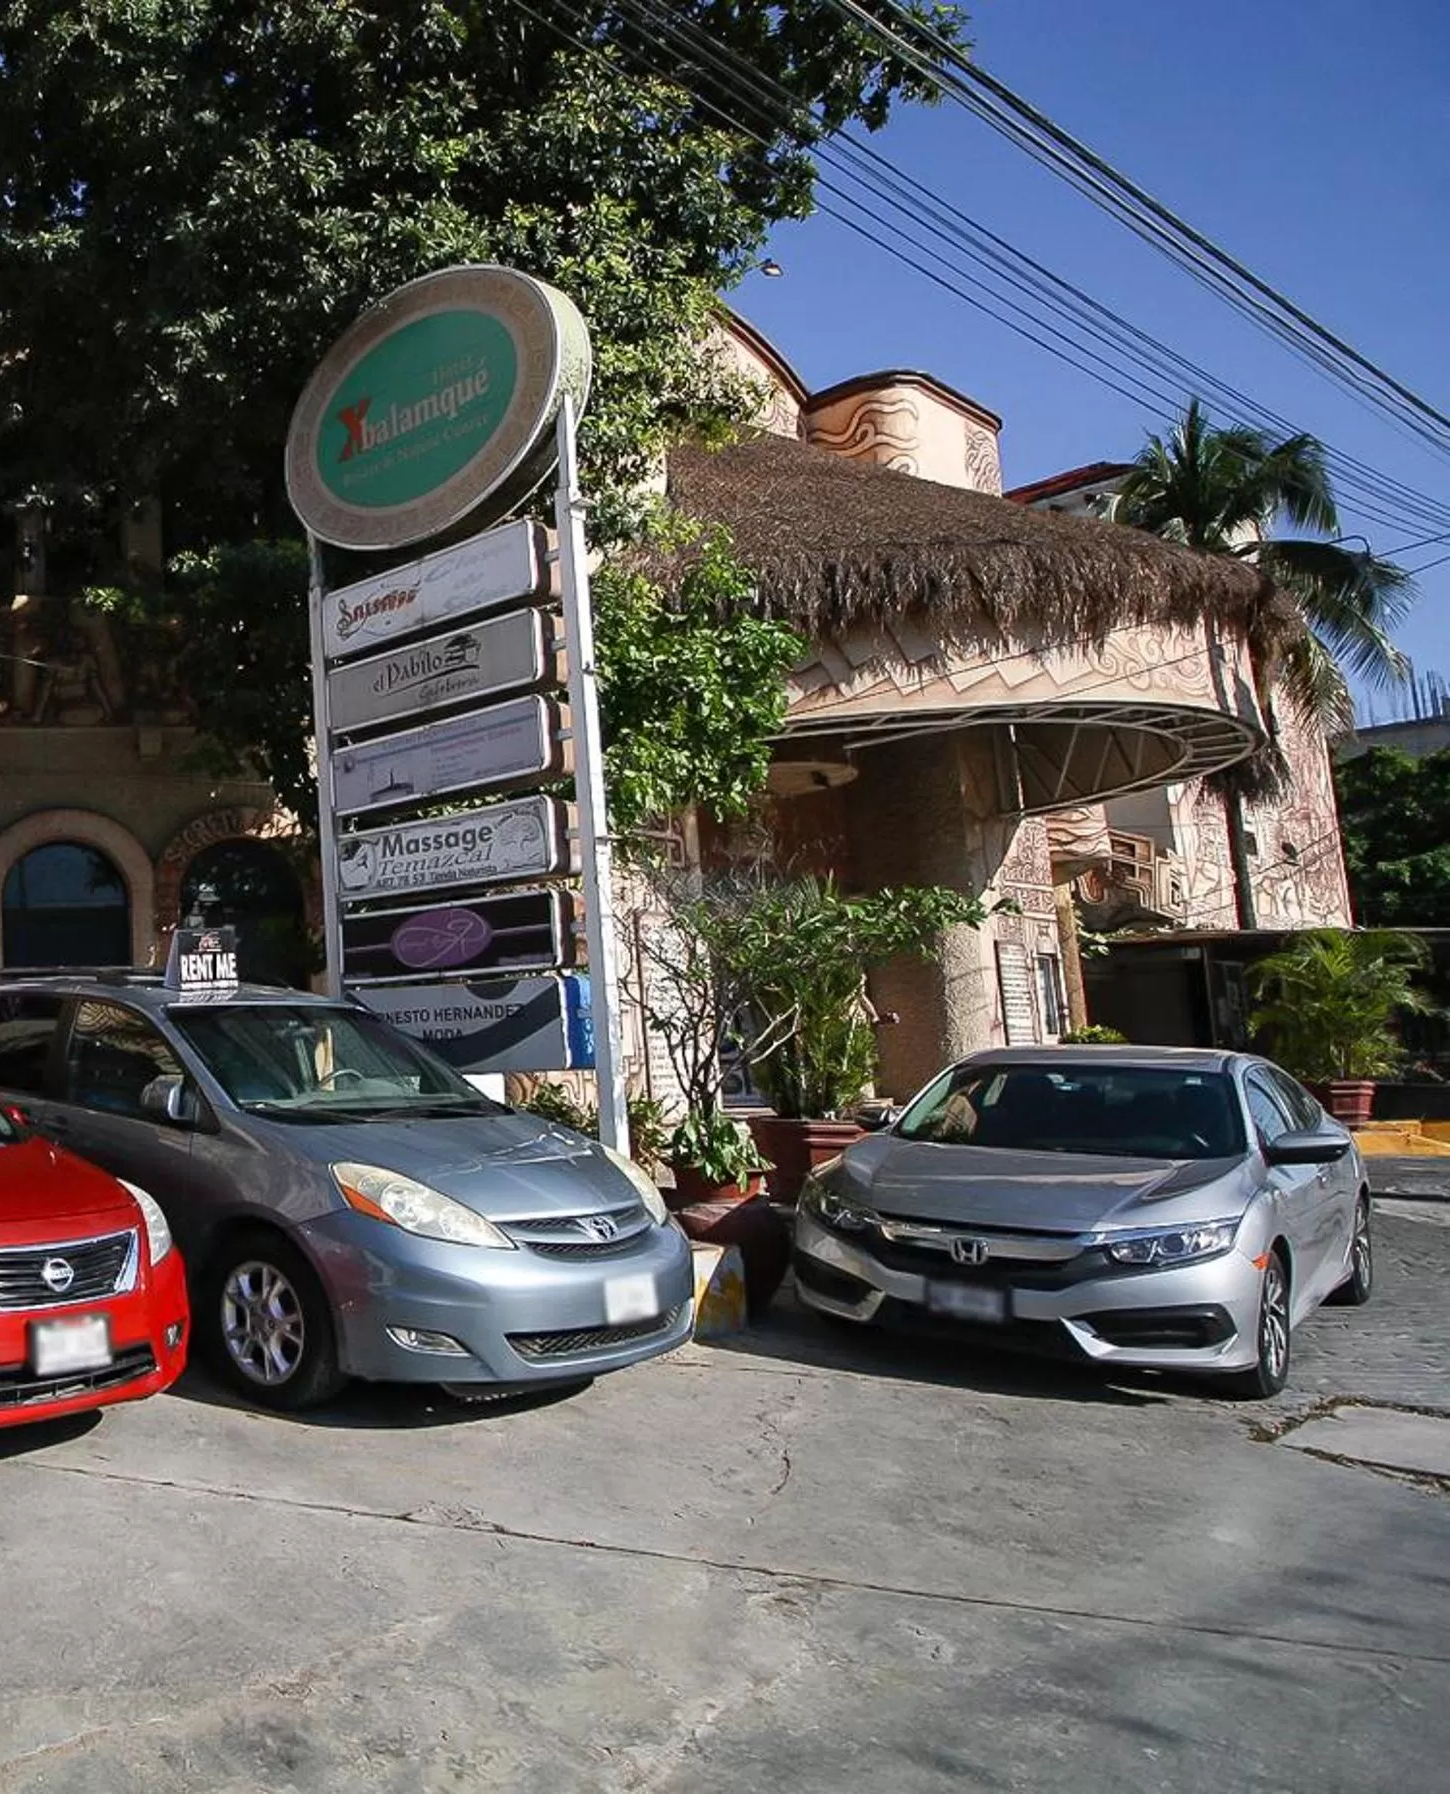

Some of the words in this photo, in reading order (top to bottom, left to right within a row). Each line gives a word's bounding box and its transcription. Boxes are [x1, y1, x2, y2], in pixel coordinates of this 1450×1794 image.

[380, 823, 493, 859] Massage
[377, 844, 494, 876] Temazcal
[180, 953, 213, 981] RENT
[216, 952, 238, 979] ME
[434, 1003, 524, 1022] HERNANDEZ
